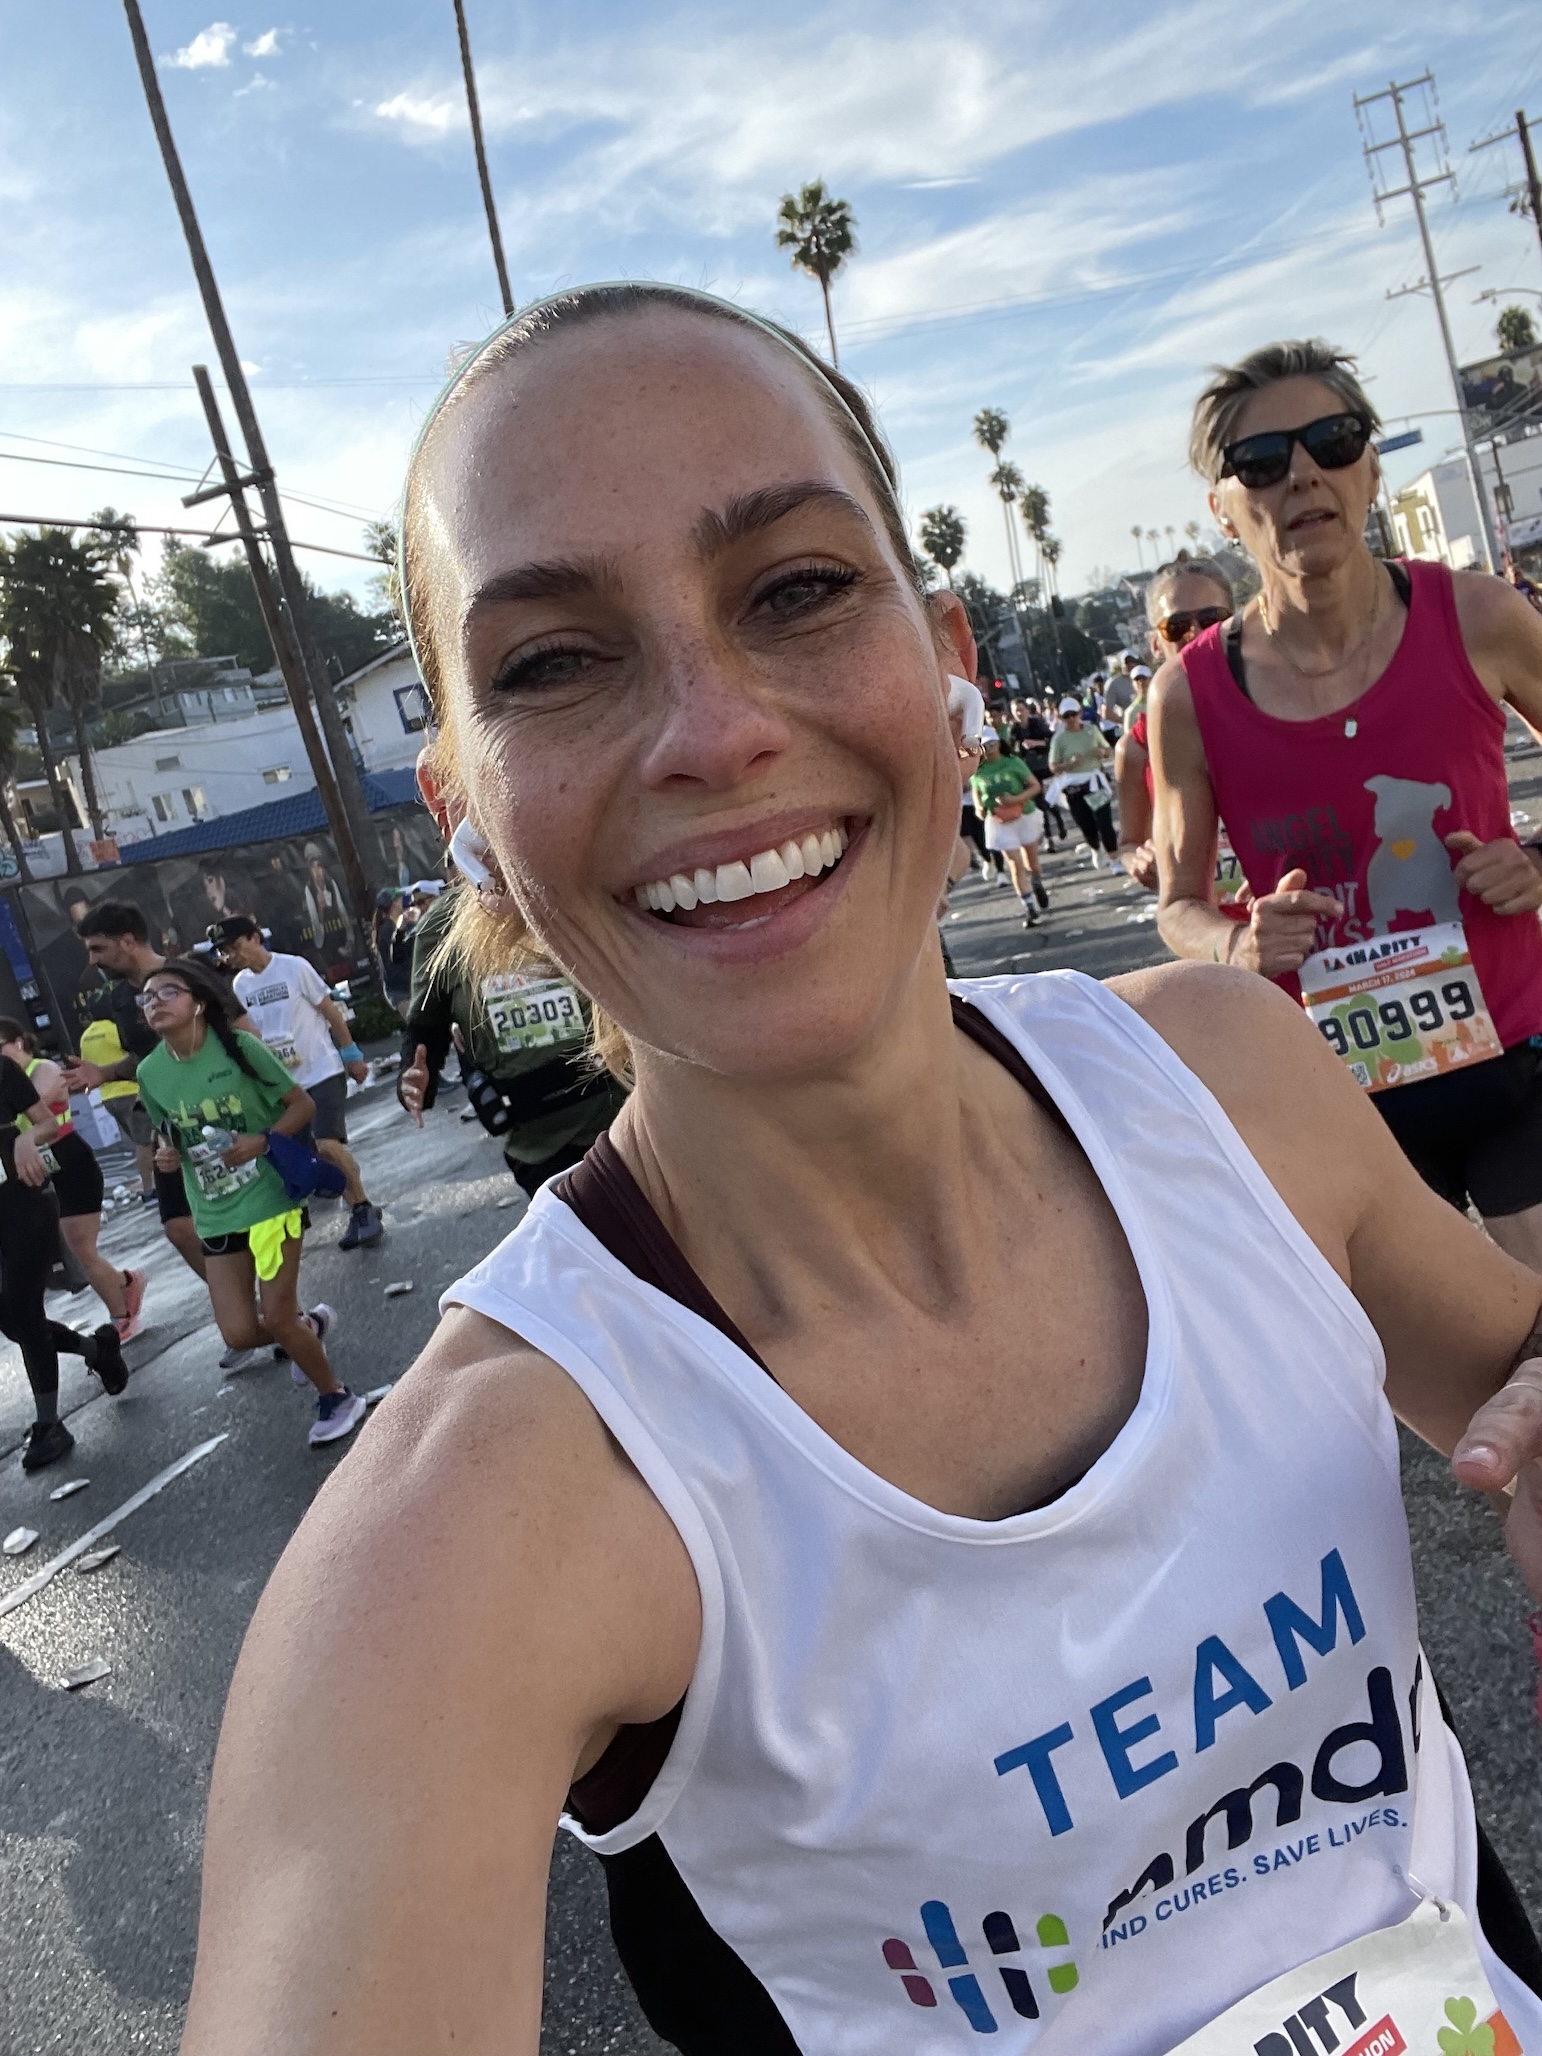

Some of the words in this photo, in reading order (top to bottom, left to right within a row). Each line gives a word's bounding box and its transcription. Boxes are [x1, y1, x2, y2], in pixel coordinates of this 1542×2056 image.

[1250, 803, 1351, 854] ANGEL
[1345, 935, 1423, 966] CHARITY
[494, 995, 575, 1033] 20303
[1348, 977, 1381, 993] MARCH
[1317, 979, 1476, 1056] 90999
[993, 1547, 1366, 1837] TEAM
[1102, 1653, 1423, 1934] nmd
[1099, 1914, 1148, 1949] IND
[1154, 1867, 1248, 1922] CURES.
[1252, 1833, 1321, 1876] SAVE
[1327, 1807, 1409, 1848] LIVES.
